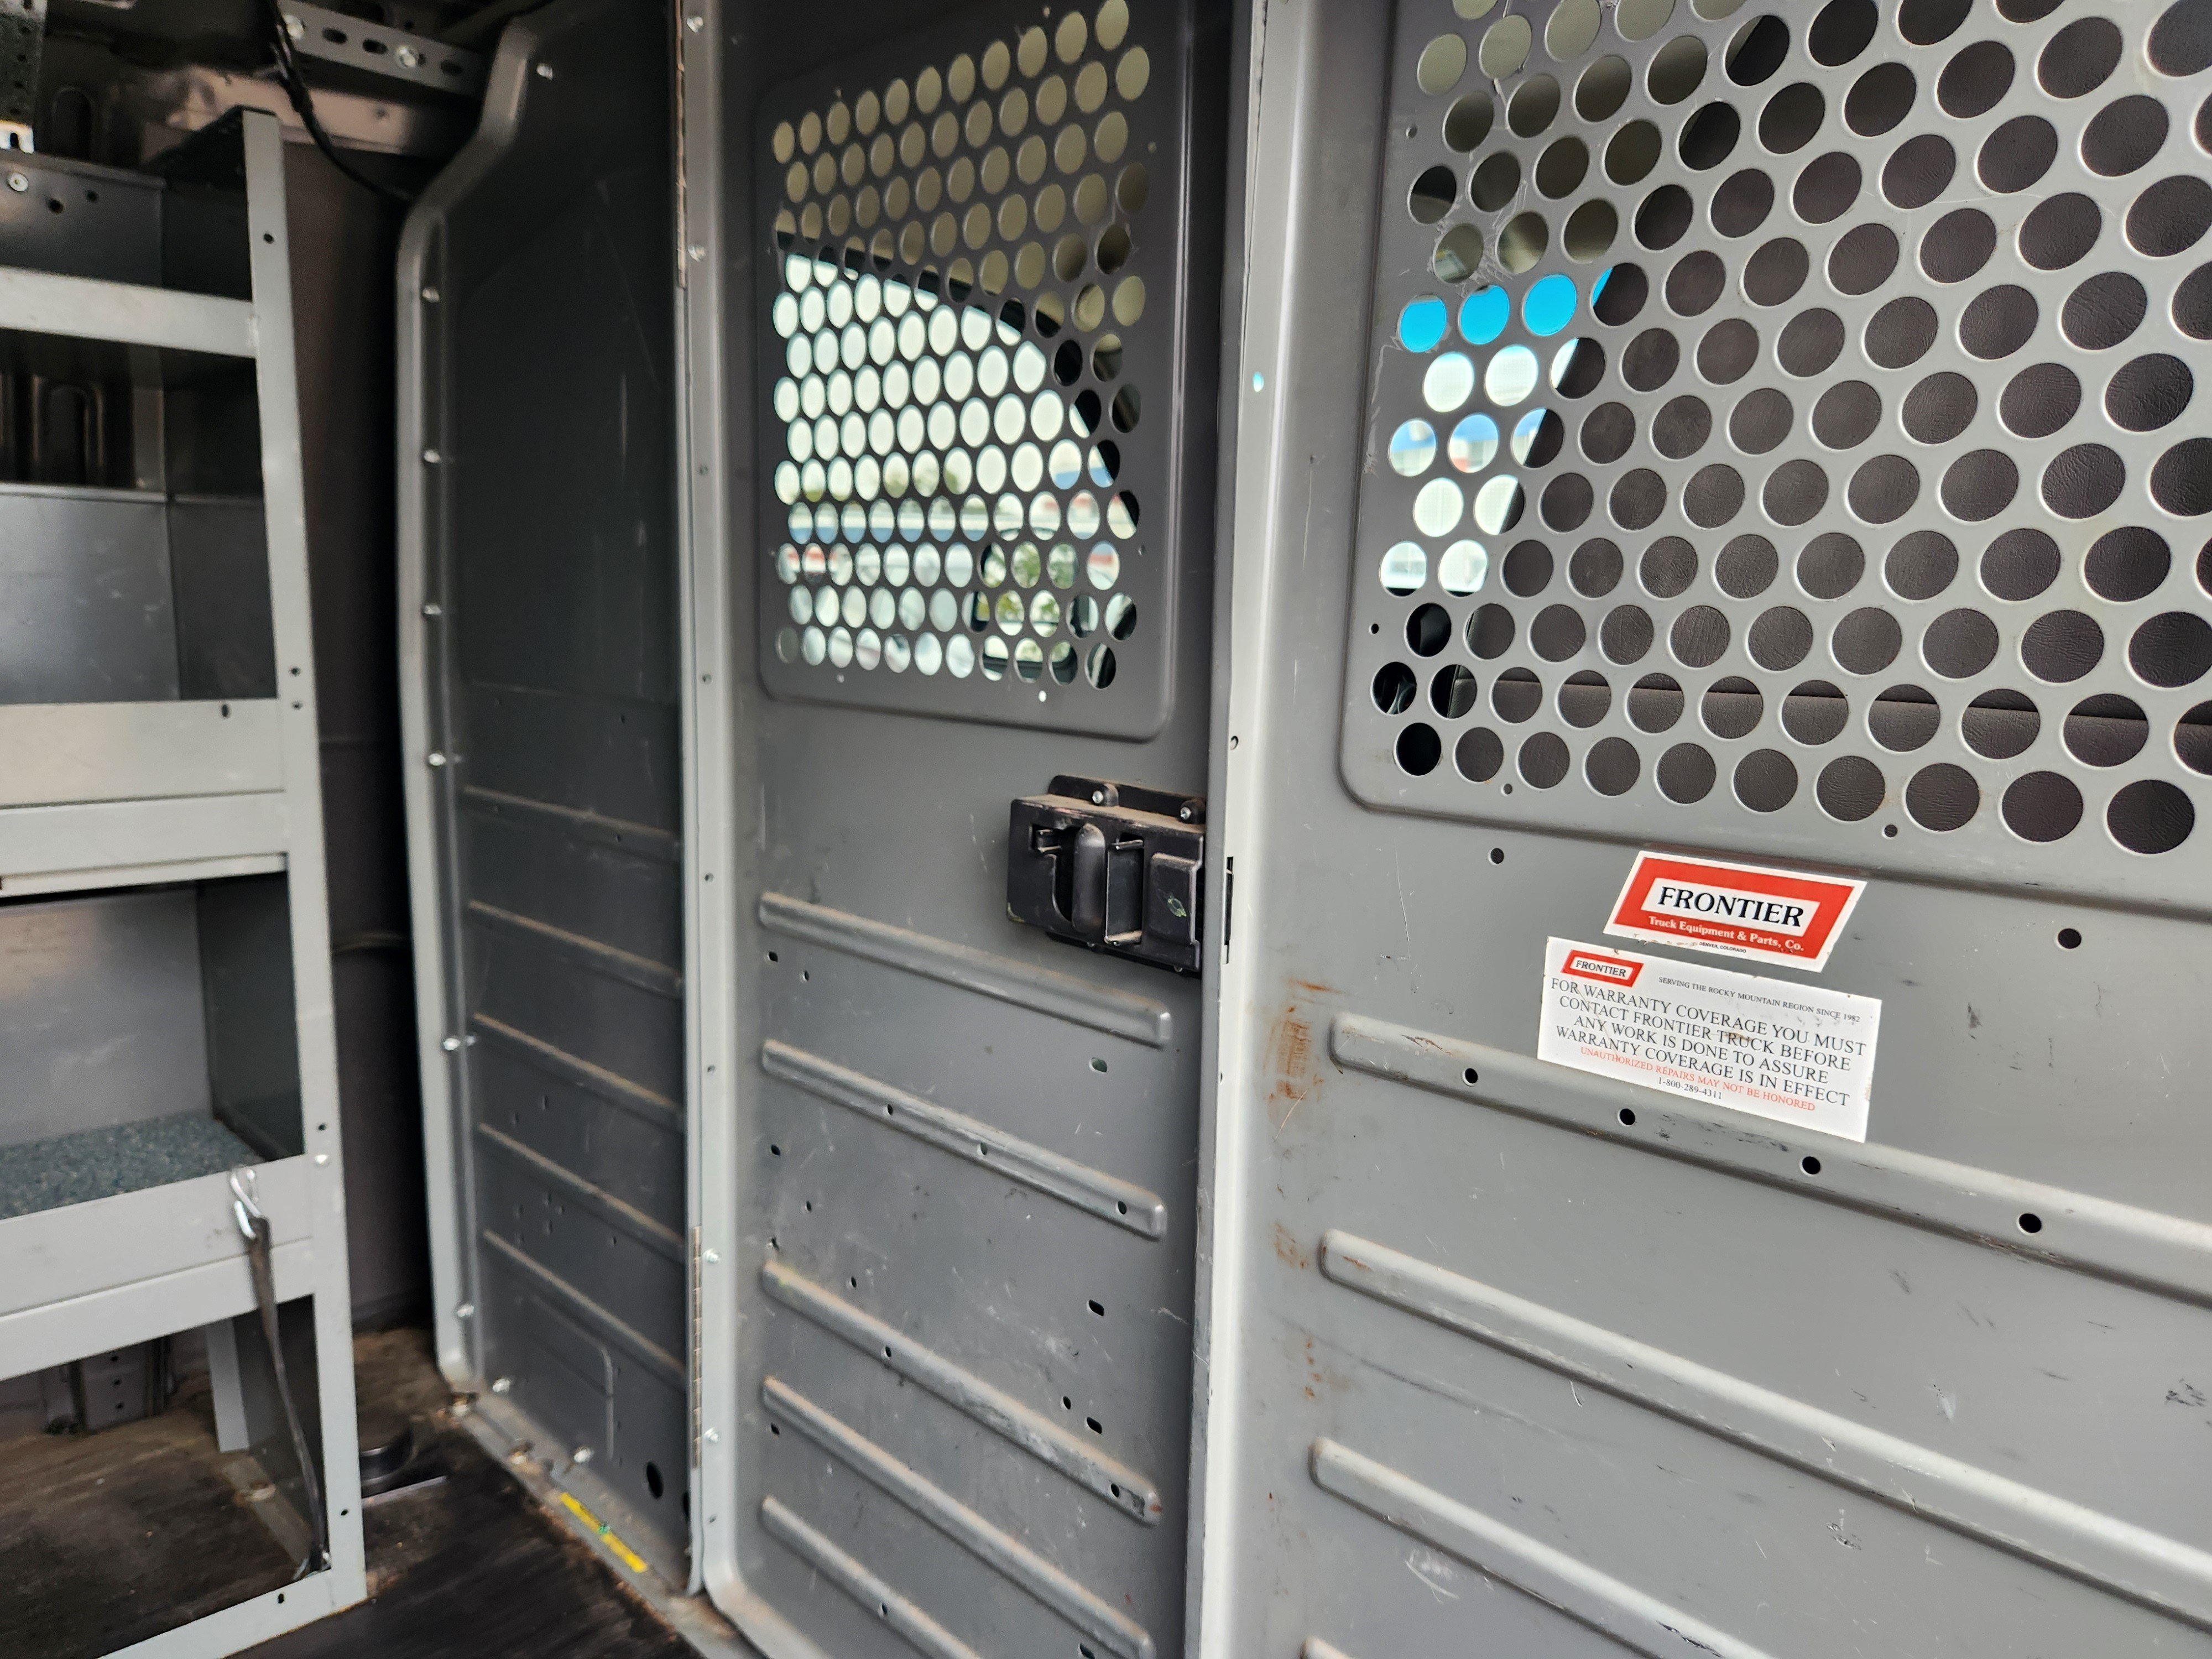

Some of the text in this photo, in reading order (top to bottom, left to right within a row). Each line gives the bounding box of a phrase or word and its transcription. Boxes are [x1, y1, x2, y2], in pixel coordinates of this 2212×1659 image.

[1657, 886, 1804, 927] FRONTIER
[1648, 915, 1804, 951] Truck Equipment & Parts, Co.
[1720, 945, 1746, 953] COLORADO
[1575, 960, 1626, 977] FRONTIER
[1551, 978, 1867, 1056] FOR WARRANTY COVERAGE YOU MUST
[1658, 976, 1860, 1022] SERVING THE ROCKY MOUNTAIN REGION SINCE 1982
[1559, 996, 1851, 1071] CONTACT FRONTIER TRUCK BEFORE
[1574, 1015, 1829, 1084] ANY WORK IS DONE TO ASSURE
[1556, 1025, 1850, 1107] WARRANTY COVERAGE IS IN EFFECT
[1580, 1046, 1815, 1111] UNAUTHORIZED REPAIRS MAY NOT BE HONORED
[1658, 1077, 1723, 1099] 1-800-289-4311
